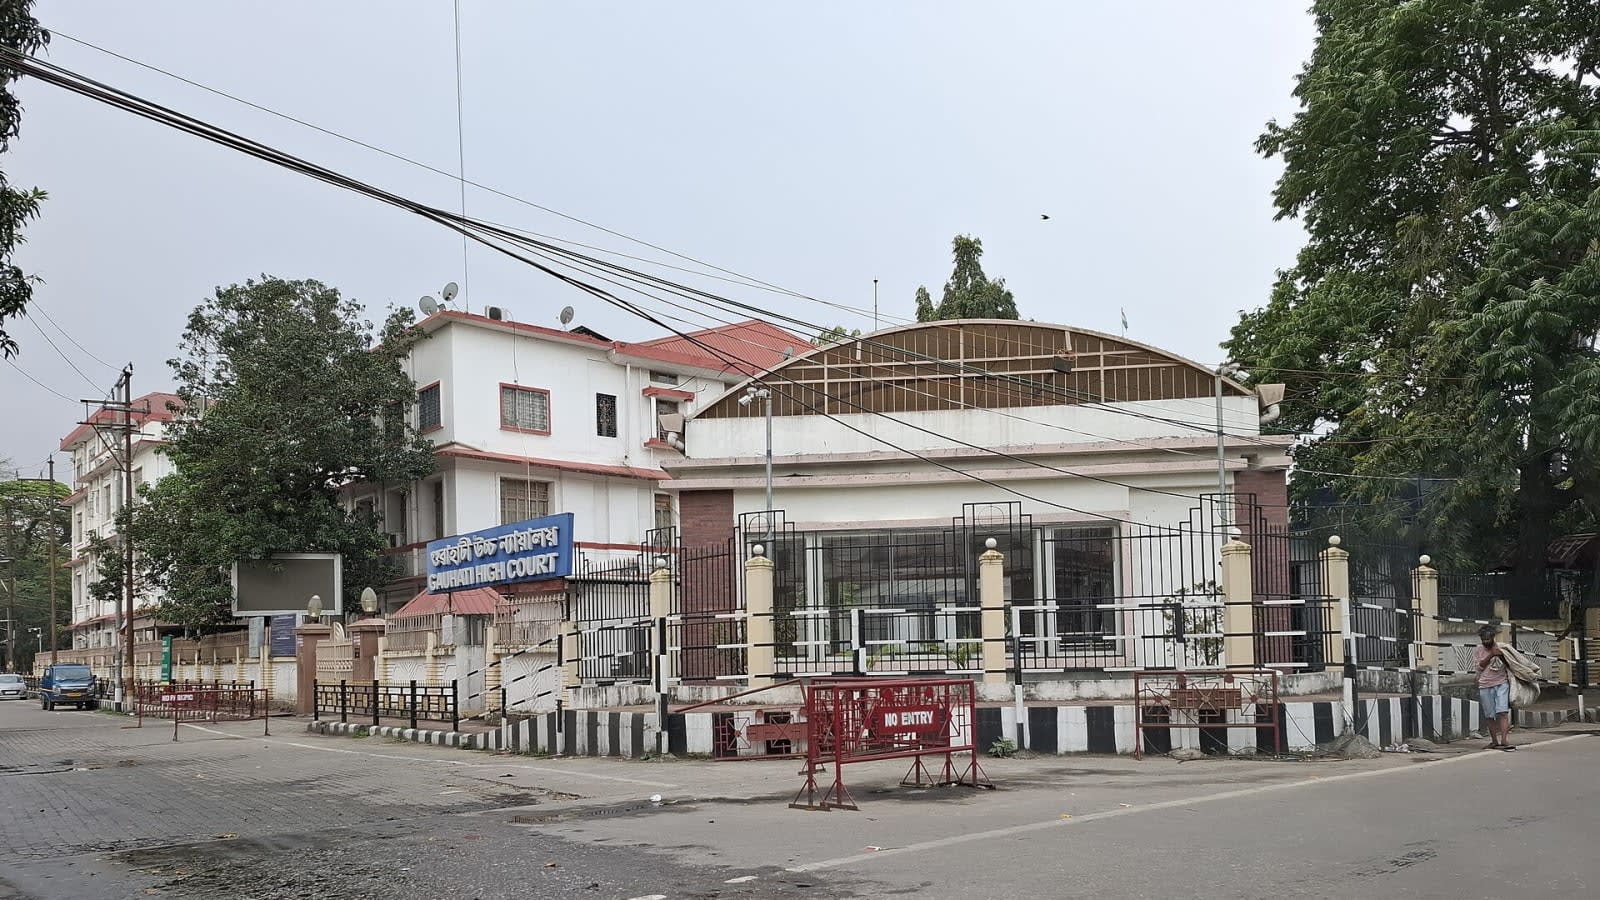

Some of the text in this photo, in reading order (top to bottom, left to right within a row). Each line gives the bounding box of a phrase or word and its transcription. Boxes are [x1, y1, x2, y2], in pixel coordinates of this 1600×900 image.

[429, 553, 559, 591] GAUHATI HIGH COURT
[885, 711, 933, 727] NO ENTRY
